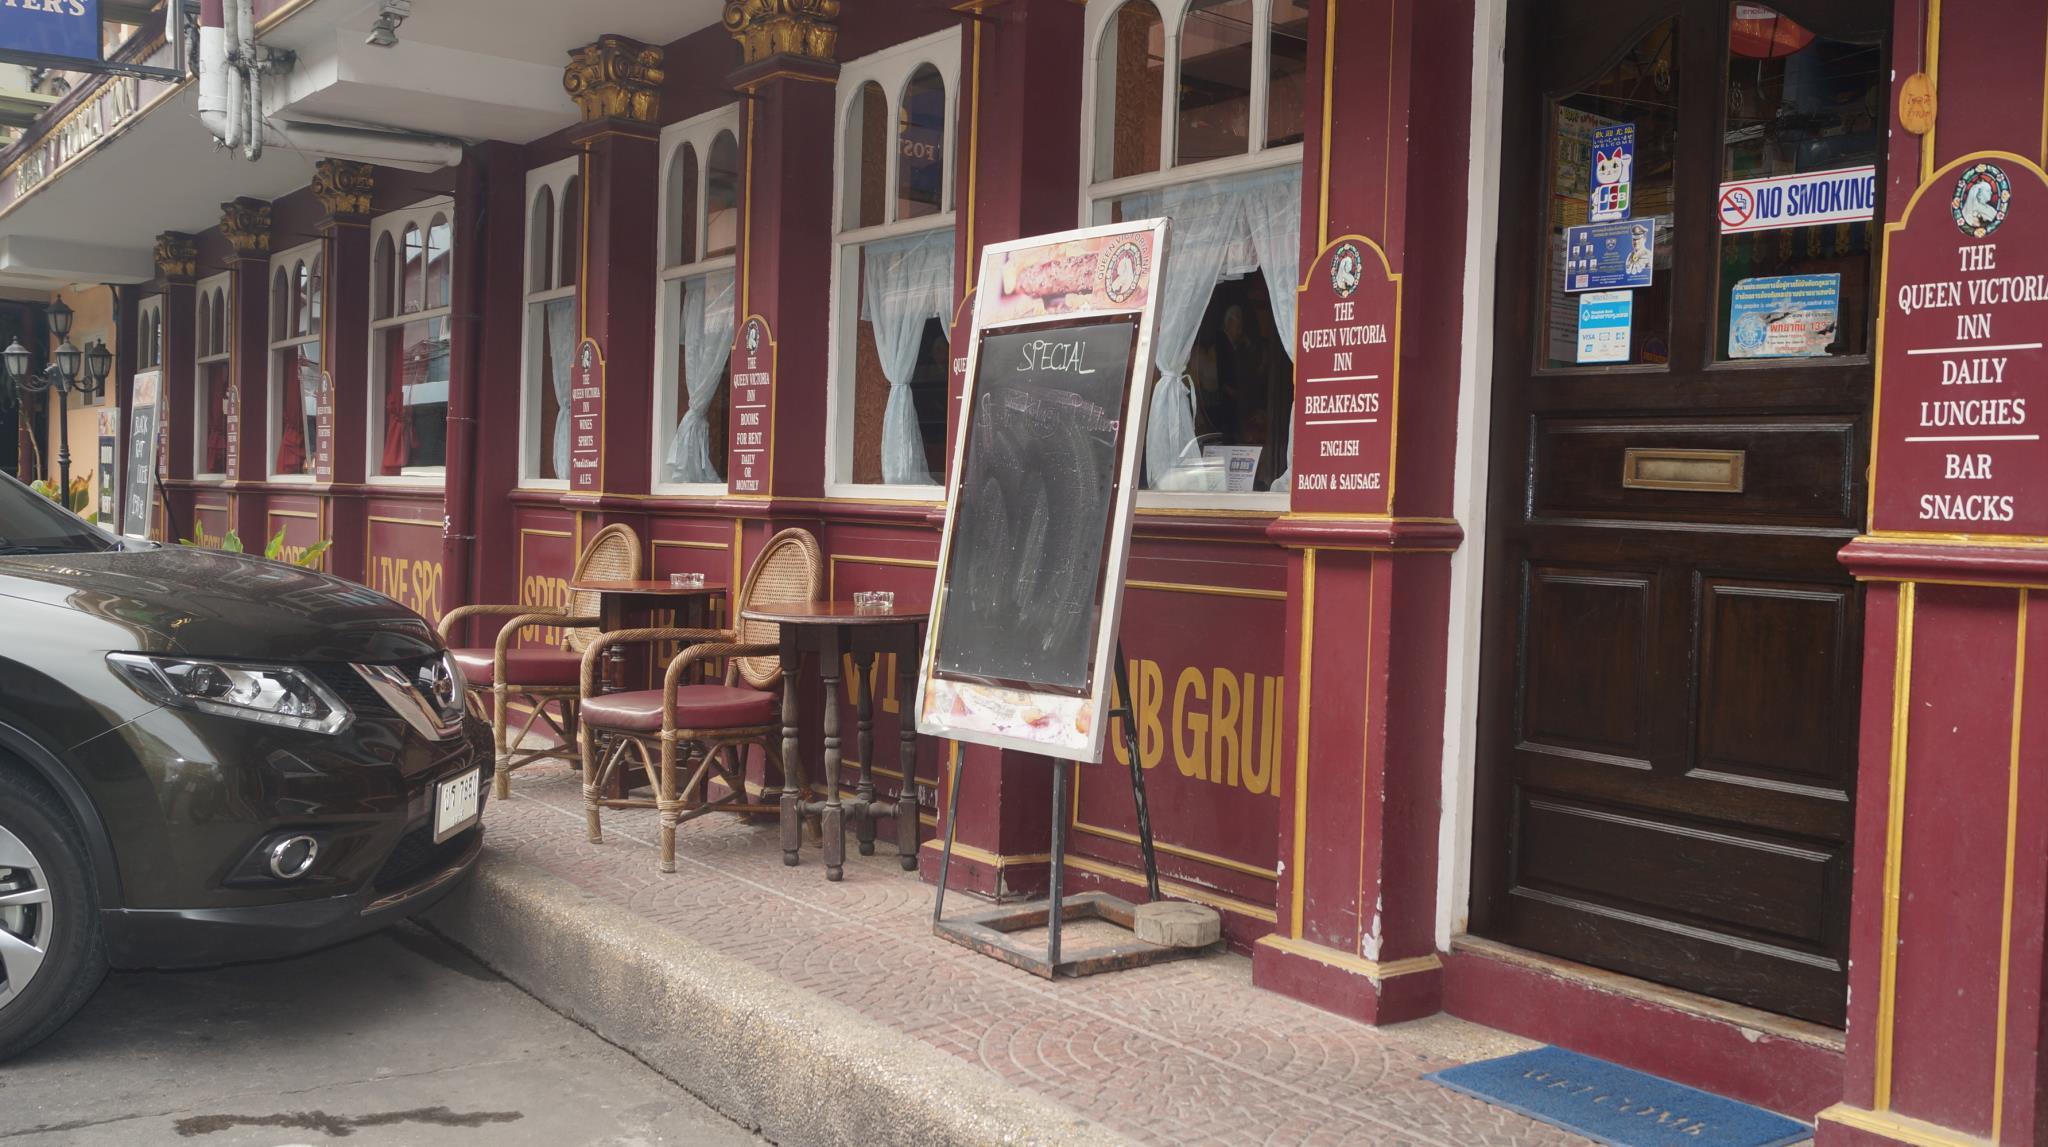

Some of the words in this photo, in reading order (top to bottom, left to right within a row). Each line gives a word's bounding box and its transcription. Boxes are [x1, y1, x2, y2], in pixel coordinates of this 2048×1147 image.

[1594, 139, 1633, 149] WELCOME
[1756, 186, 1782, 219] NO
[1787, 175, 1875, 216] SMOKING
[1959, 244, 1996, 271] THE
[1898, 281, 1962, 315] QUEEN
[1334, 302, 1355, 322] THE
[1956, 313, 1992, 340] INN
[1302, 328, 1337, 352] QUEEN
[1339, 324, 1387, 347] VICTORIA
[747, 357, 757, 369] THE
[1017, 339, 1095, 374] SPECIAL
[1333, 352, 1353, 371] INN
[733, 374, 749, 389] QUEEN
[749, 373, 770, 386] VICTORIA
[1941, 358, 2007, 386] DAILY
[747, 390, 756, 402] INN
[1304, 393, 1379, 415] BREAKFASTS
[740, 413, 759, 426] ROOMS
[1919, 398, 2026, 427] LUNCHES
[578, 436, 594, 447] SPIRITS
[736, 433, 748, 445] FOR
[748, 432, 762, 445] RENT
[1320, 440, 1360, 457] ENGLISH
[573, 458, 598, 468] Traditional
[741, 454, 755, 465] DAILY
[1944, 454, 1992, 479] BAR
[579, 474, 592, 485] ALES
[744, 467, 752, 477] OR
[1298, 474, 1328, 491] BACON
[1330, 473, 1337, 490] &
[1339, 472, 1381, 490] SAUSAGE
[736, 480, 759, 491] MONTHLY
[1919, 495, 2014, 522] SNACKS
